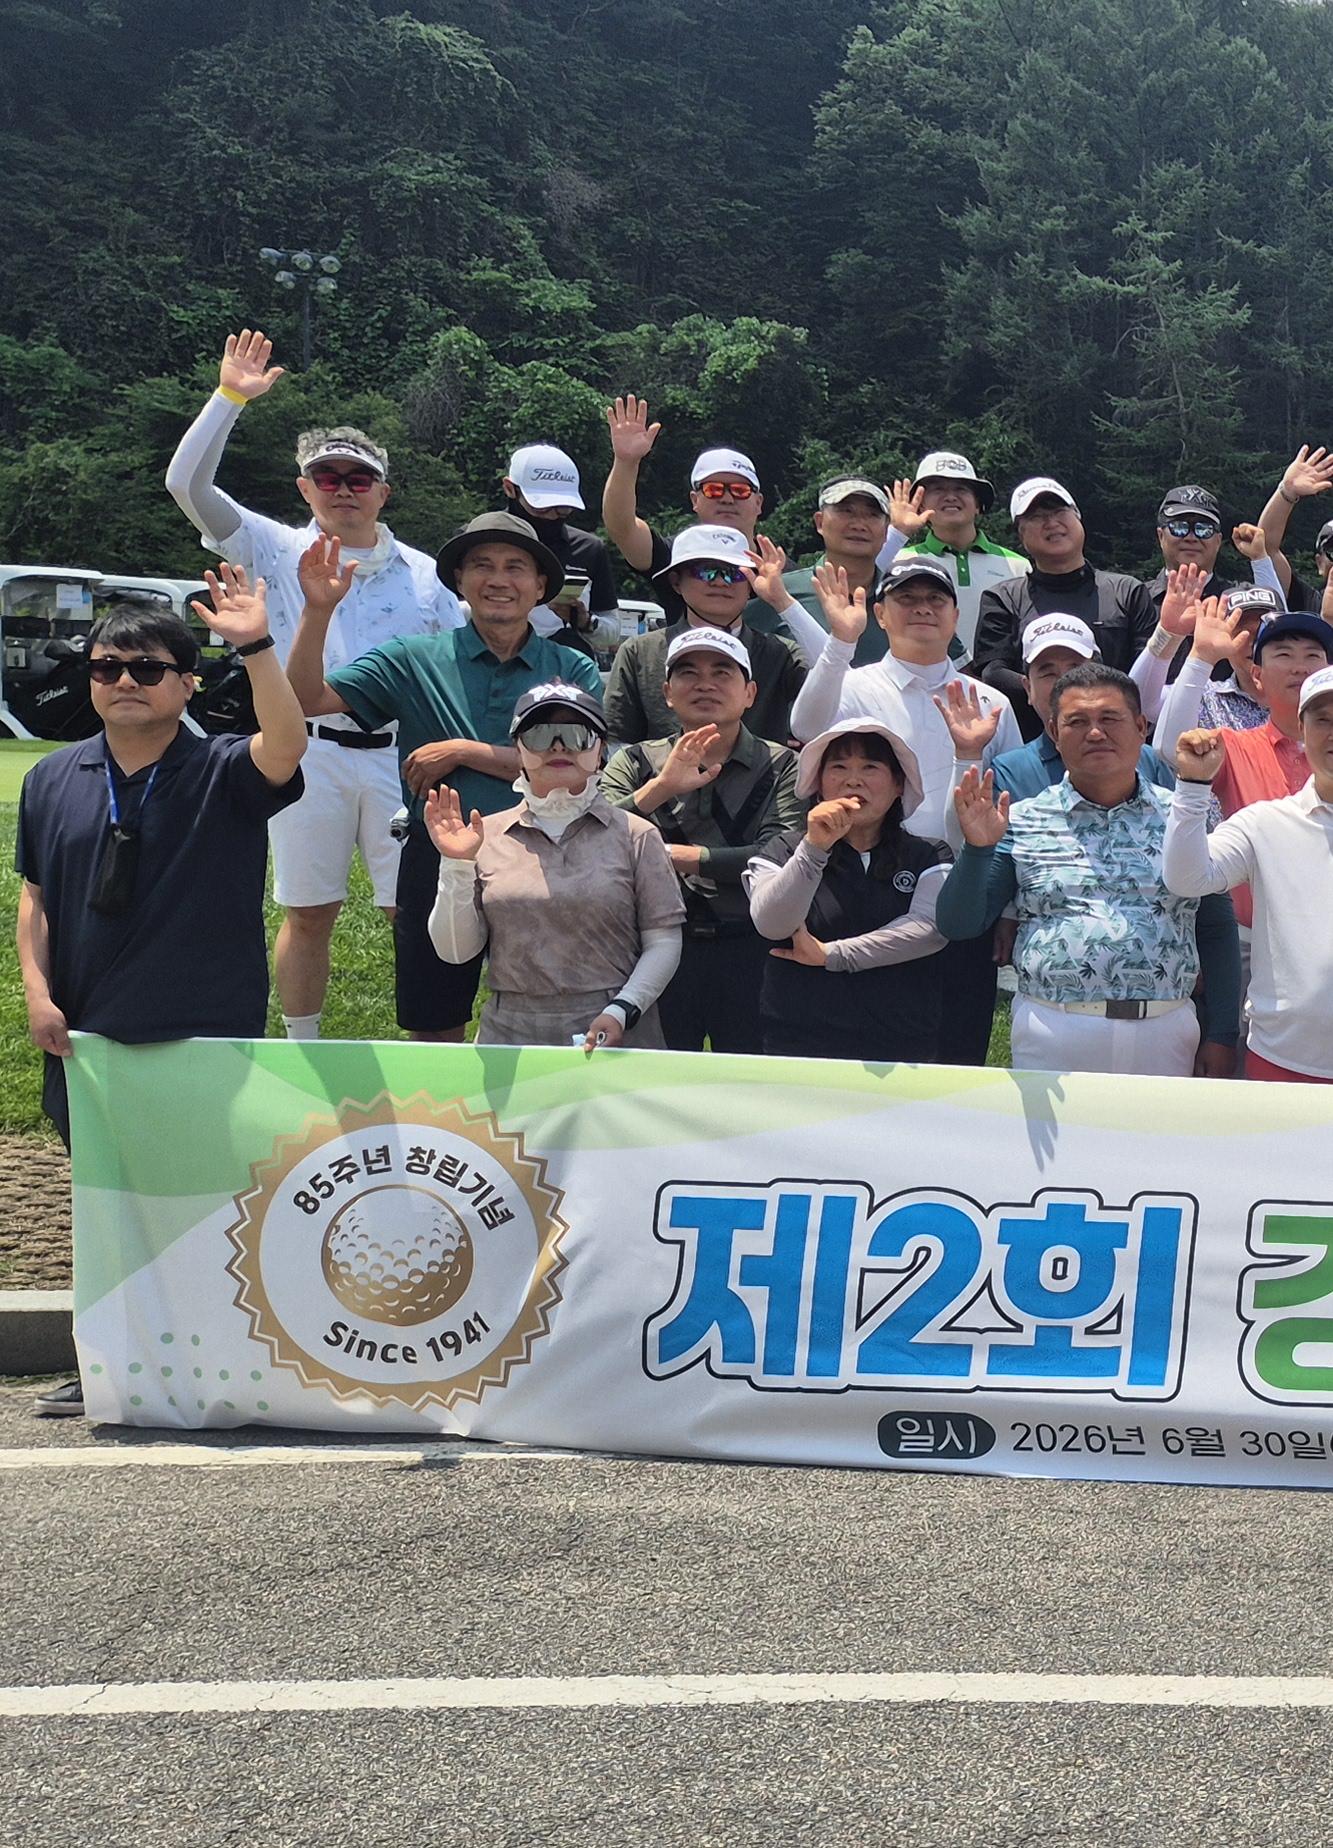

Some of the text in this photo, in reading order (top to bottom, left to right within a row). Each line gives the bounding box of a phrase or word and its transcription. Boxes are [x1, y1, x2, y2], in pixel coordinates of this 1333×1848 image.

[530, 467, 576, 484] Titleist
[1230, 592, 1271, 606] PING
[676, 632, 737, 650] Titleist
[1030, 622, 1084, 642] Titleist
[292, 1144, 516, 1231] 85주년 창립기념
[648, 1186, 1194, 1396] 제2회
[322, 1310, 491, 1364] Since 1941
[896, 1417, 976, 1454] 일시
[1009, 1421, 1147, 1457] 2026년
[1161, 1427, 1227, 1459] 6월
